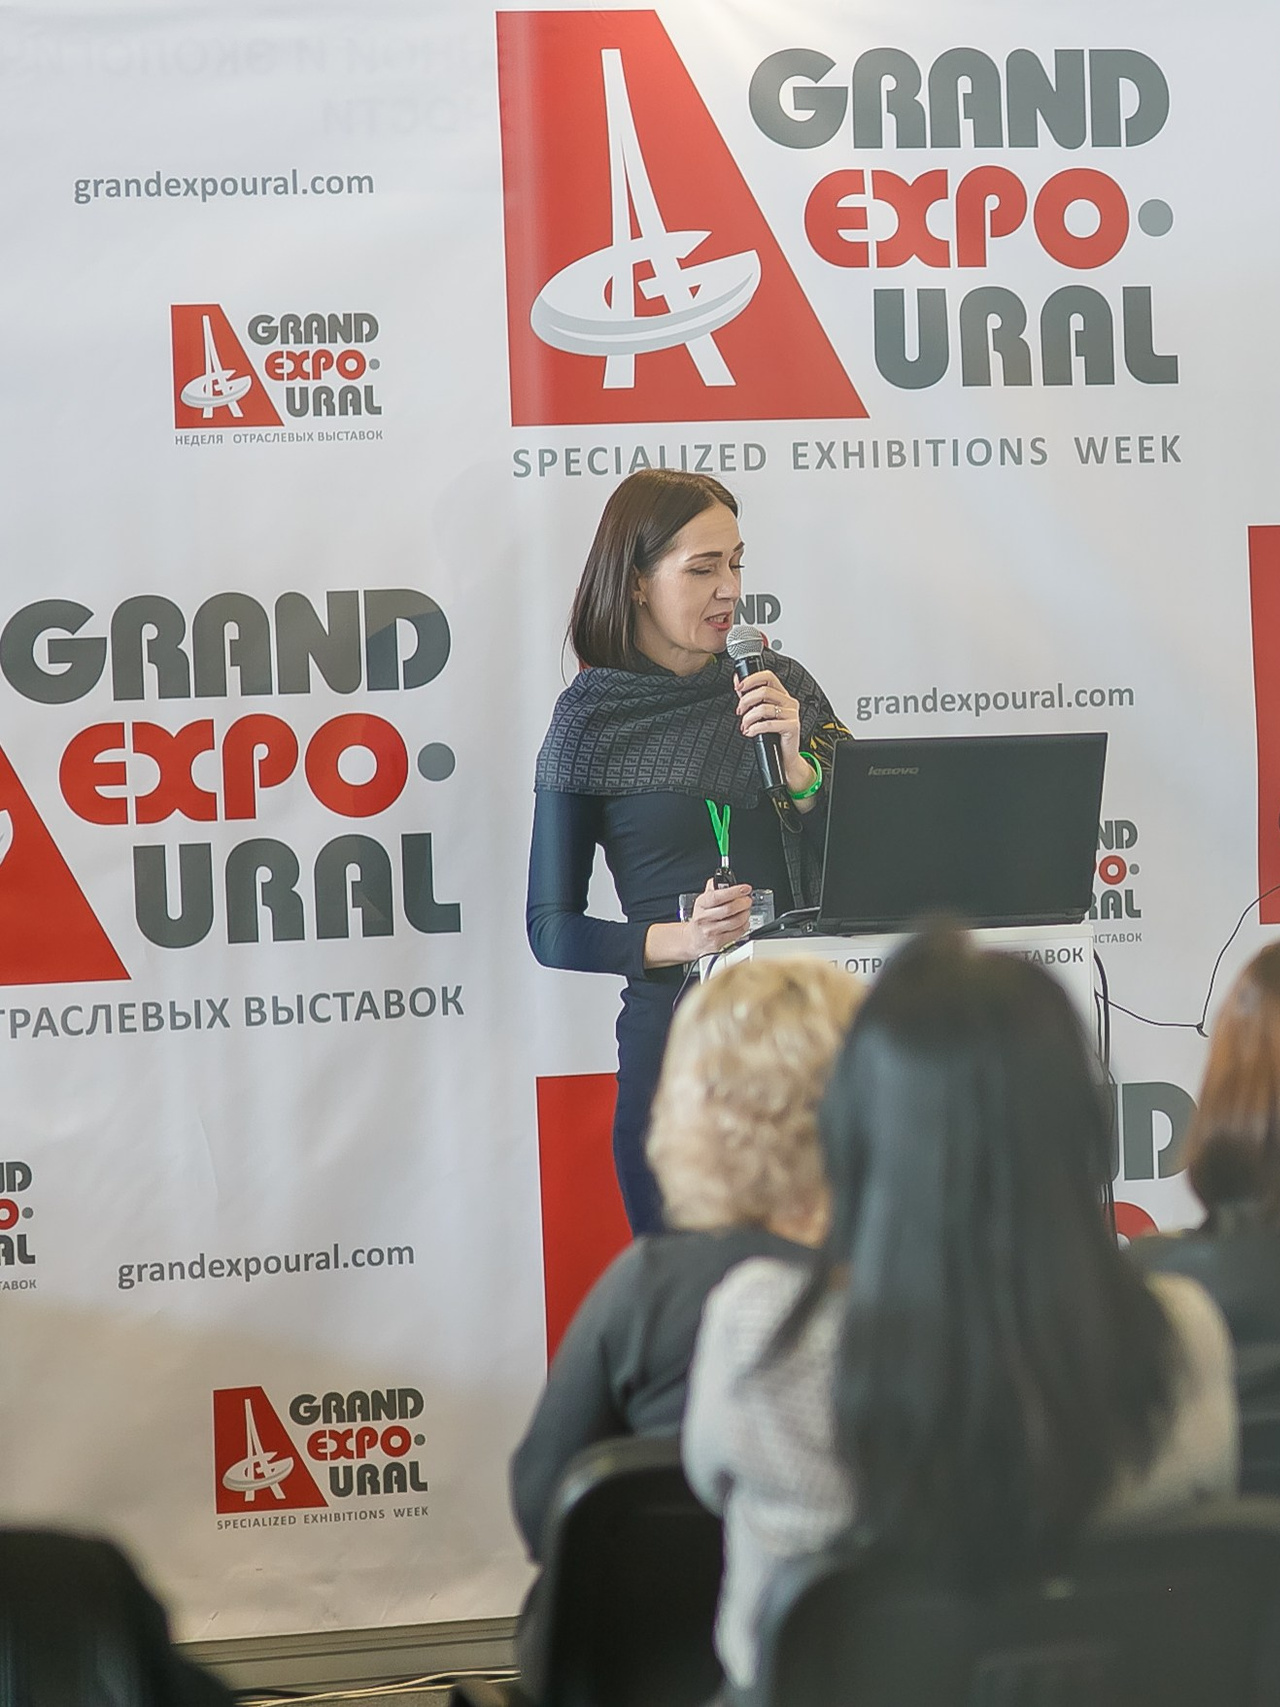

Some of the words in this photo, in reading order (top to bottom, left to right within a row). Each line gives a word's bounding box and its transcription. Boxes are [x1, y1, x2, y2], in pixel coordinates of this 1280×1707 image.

[749, 47, 1169, 150] GRAND
[75, 169, 373, 204] grandexpoural.com
[248, 313, 378, 345] GRAND
[874, 285, 1179, 390] URAL
[286, 385, 382, 417] URAL
[175, 435, 223, 447] НЕДЕЛЯ
[233, 432, 313, 443] ОТРАСЛЕВЫХ
[318, 430, 383, 441] ВЫСТАВОК
[512, 443, 767, 478] SPECIALIZED
[793, 437, 1047, 470] EXHIBITIONS
[1074, 435, 1181, 464] WEEK
[0, 589, 451, 704] GRAND
[857, 683, 1134, 721] grandexpoural.com
[868, 766, 919, 776] lenovo
[133, 832, 461, 949] URAL
[1089, 889, 1142, 919] AL
[1095, 932, 1143, 944] СТАВОК
[0, 998, 230, 1038] РАСЛЕВЫХ
[245, 985, 464, 1026] ВЫСТАВОК
[118, 1243, 414, 1289] grandexpoural.com
[289, 1388, 424, 1425] GRAND
[329, 1461, 428, 1497] URAL
[217, 1516, 296, 1530] SPECIALIZED
[304, 1509, 385, 1524] EXHIBITIONS
[393, 1506, 428, 1517] WEEK
